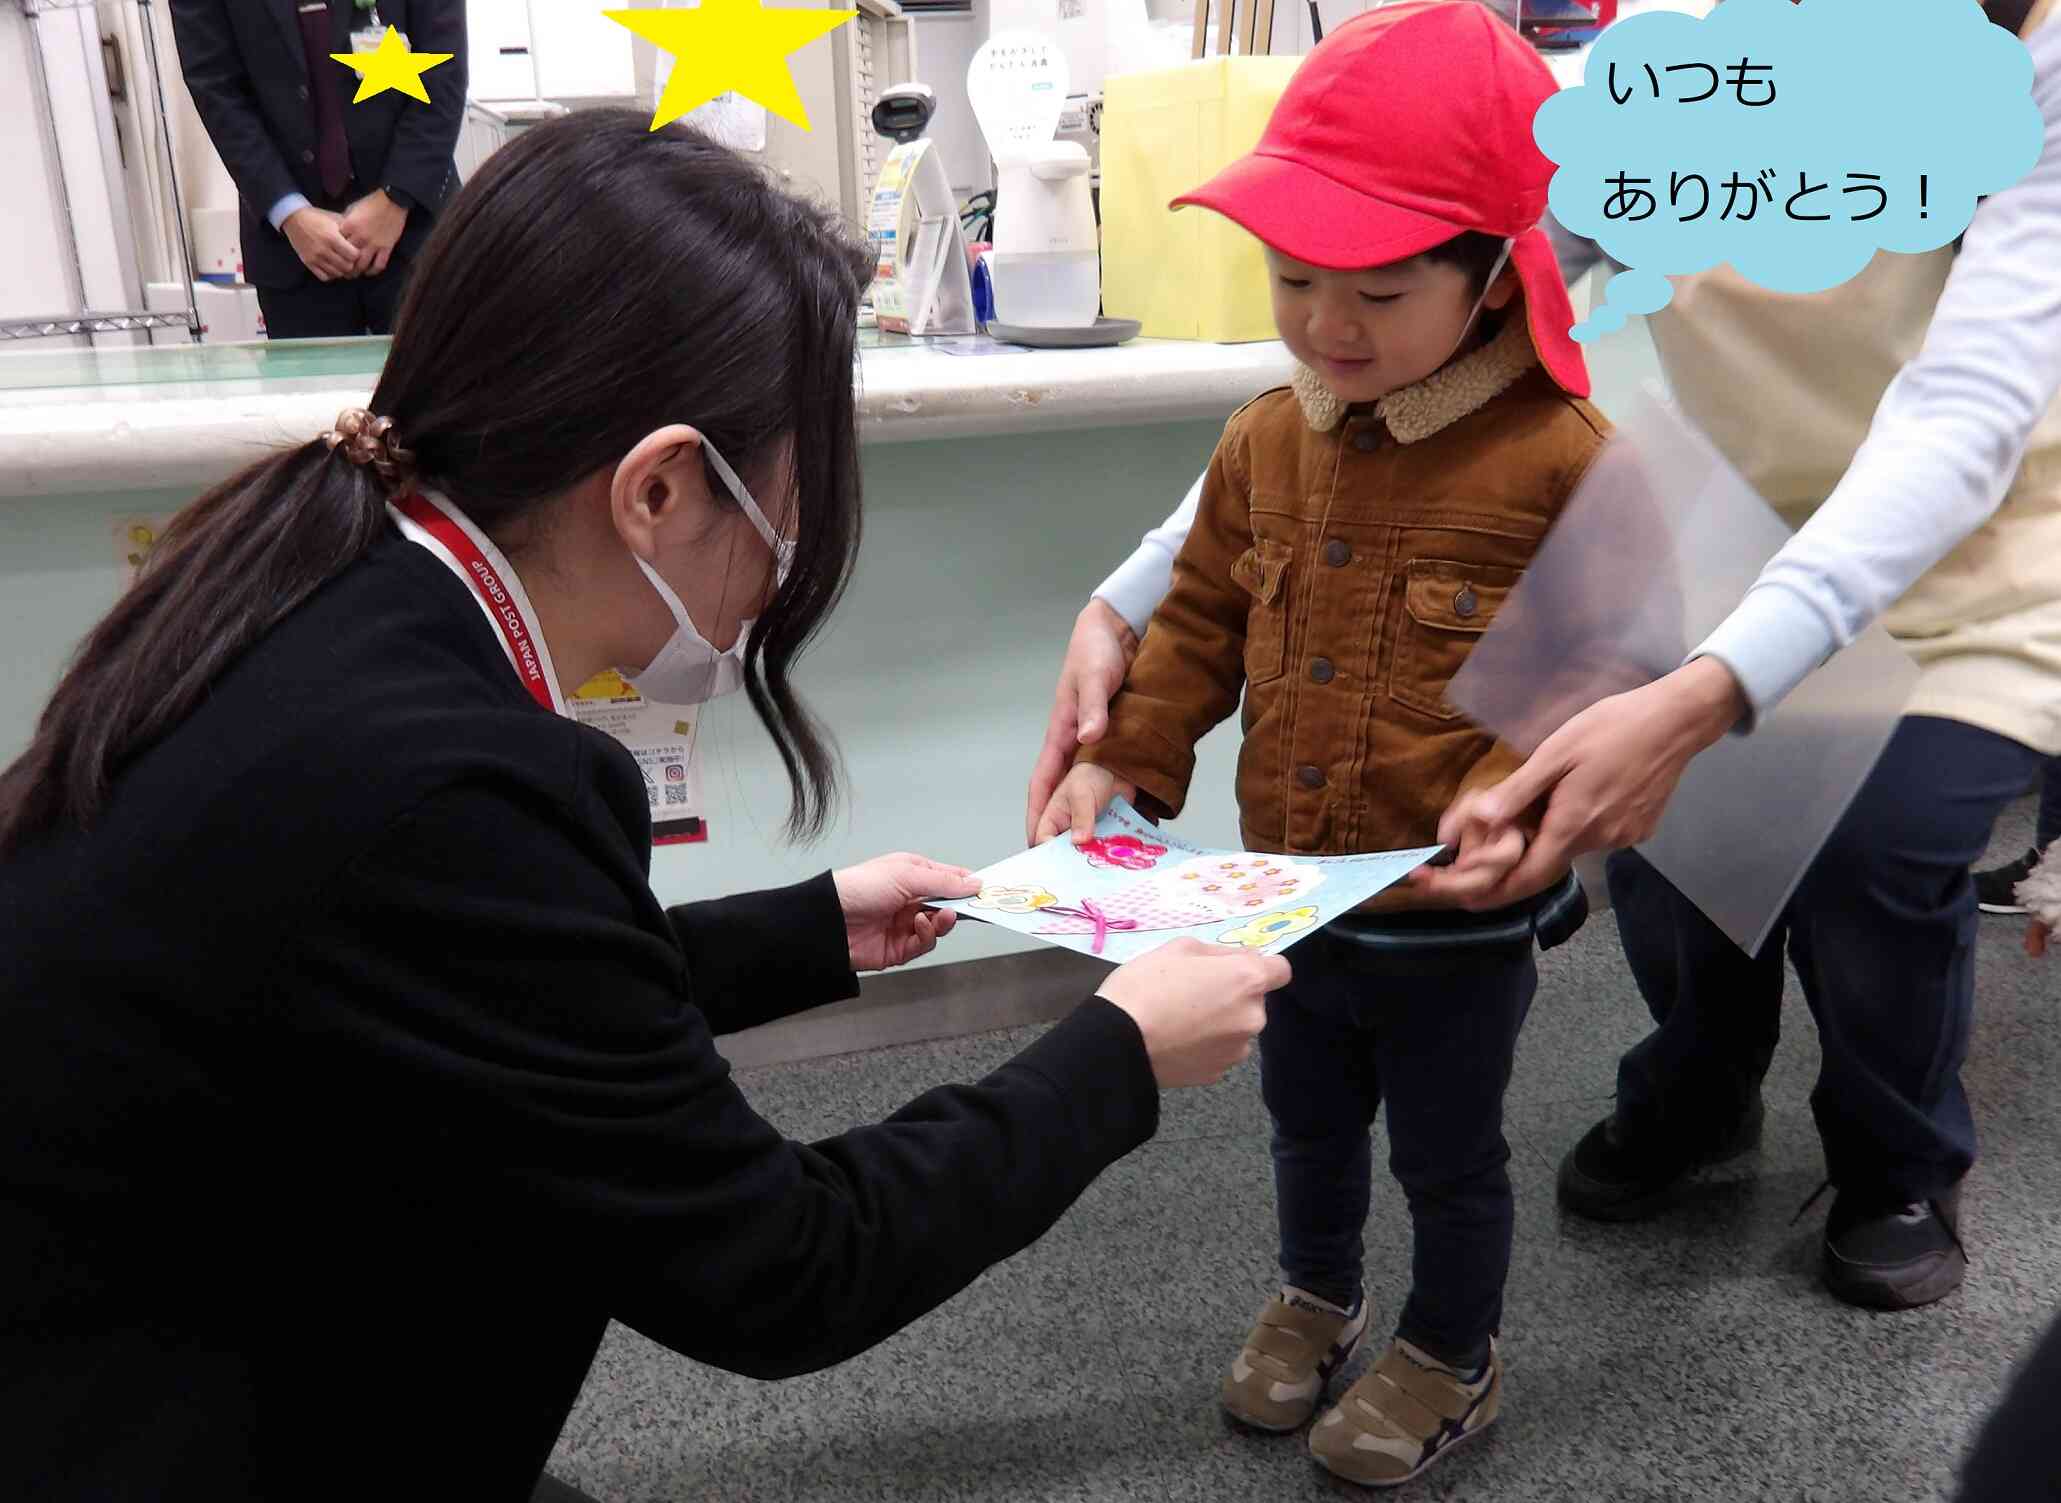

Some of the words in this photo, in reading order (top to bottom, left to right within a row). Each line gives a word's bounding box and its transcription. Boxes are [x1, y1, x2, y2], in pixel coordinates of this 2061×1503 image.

[471, 561, 505, 604] GROUP
[500, 606, 522, 638] POST
[517, 639, 541, 681] JAPAN
